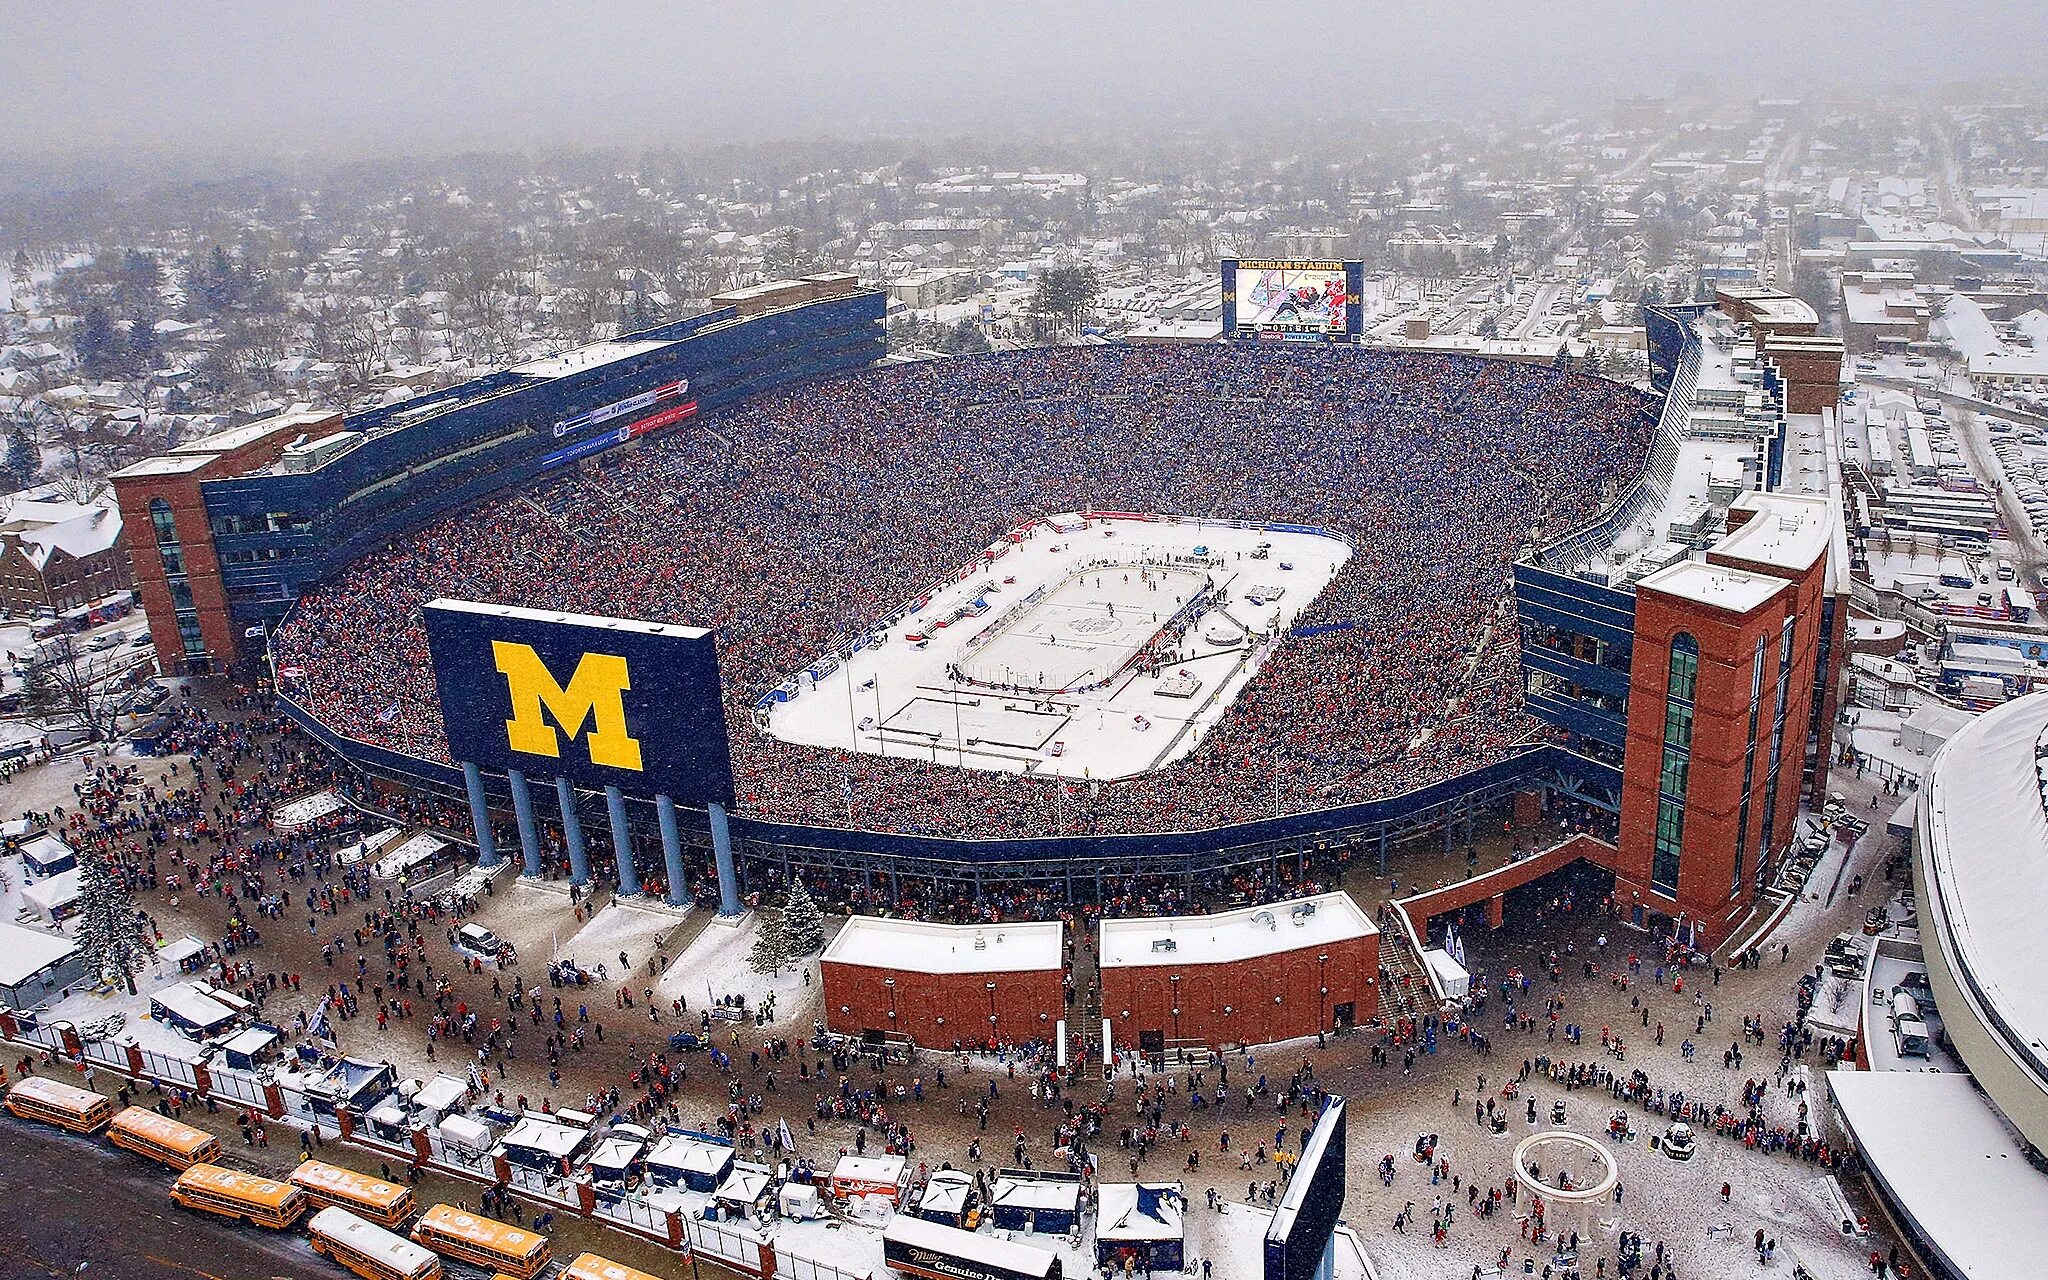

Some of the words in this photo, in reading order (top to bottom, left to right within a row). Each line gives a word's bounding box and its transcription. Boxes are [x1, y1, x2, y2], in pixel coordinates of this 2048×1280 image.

[1238, 260, 1292, 269] MICHIGAN
[1294, 261, 1343, 270] STADIUM
[491, 640, 643, 772] M
[908, 1248, 943, 1263] Miller
[935, 1262, 983, 1280] Genuine
